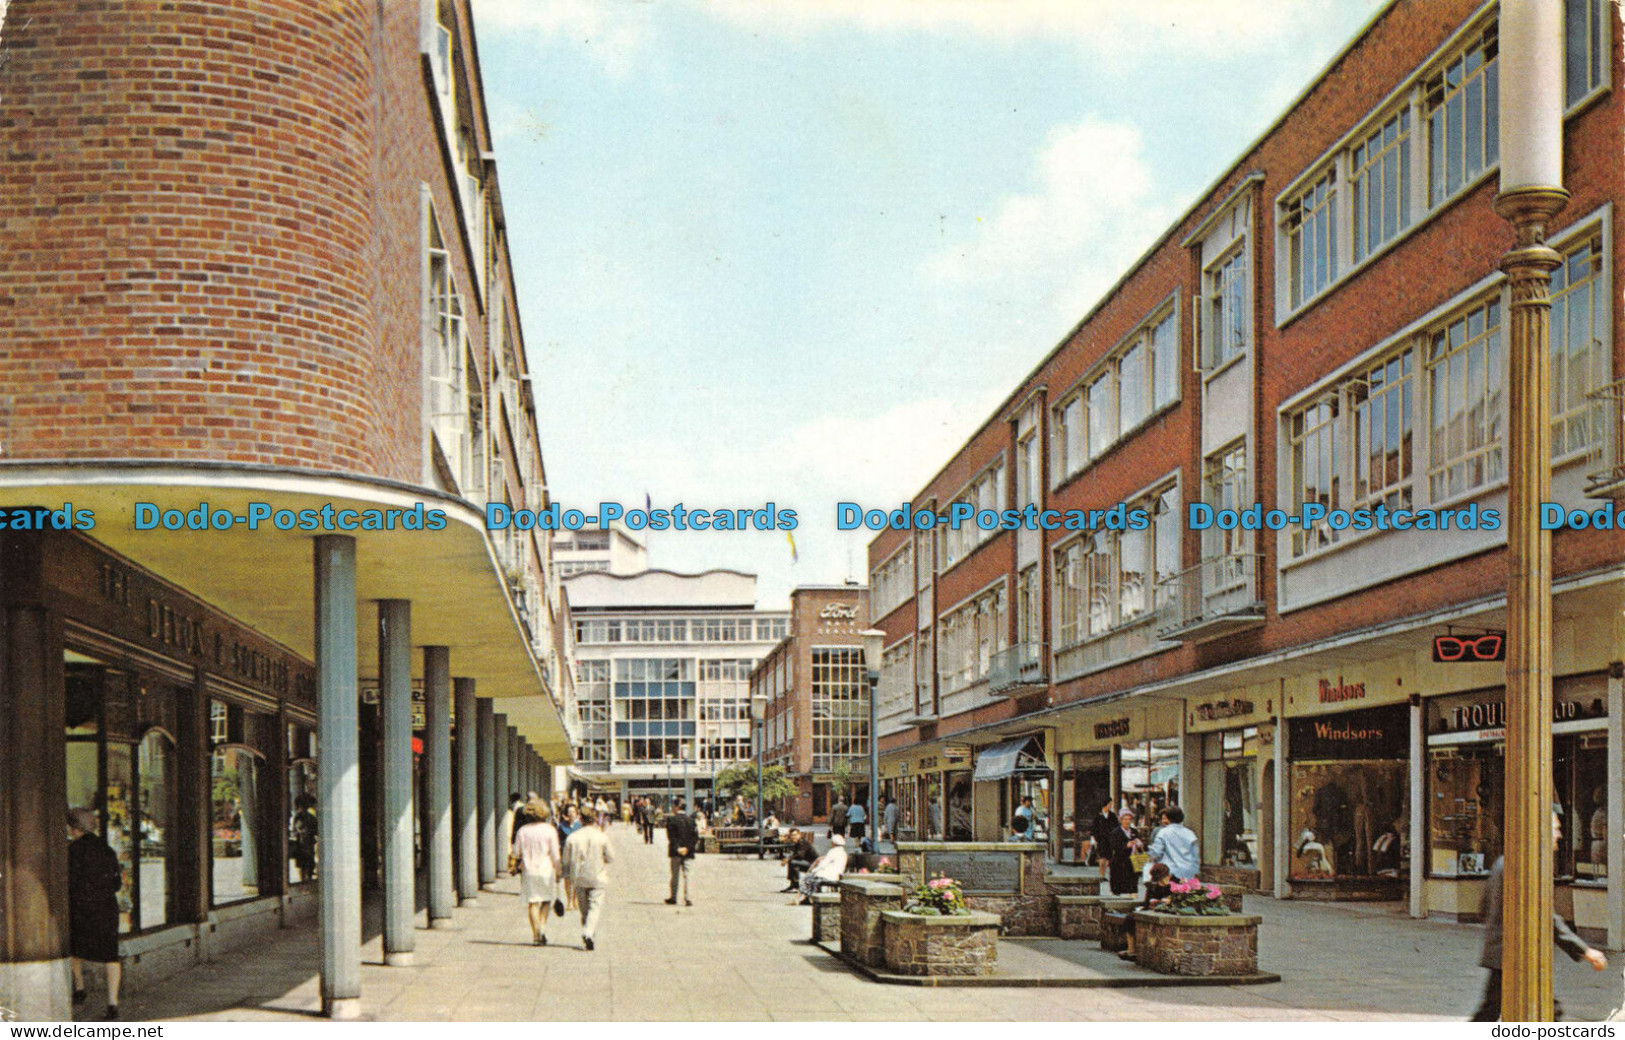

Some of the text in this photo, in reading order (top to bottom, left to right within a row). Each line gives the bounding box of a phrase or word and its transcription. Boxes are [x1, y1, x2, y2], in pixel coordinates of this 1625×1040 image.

[819, 602, 860, 618] Ford
[1318, 675, 1366, 704] Windsors
[1314, 721, 1384, 740] Windsors
